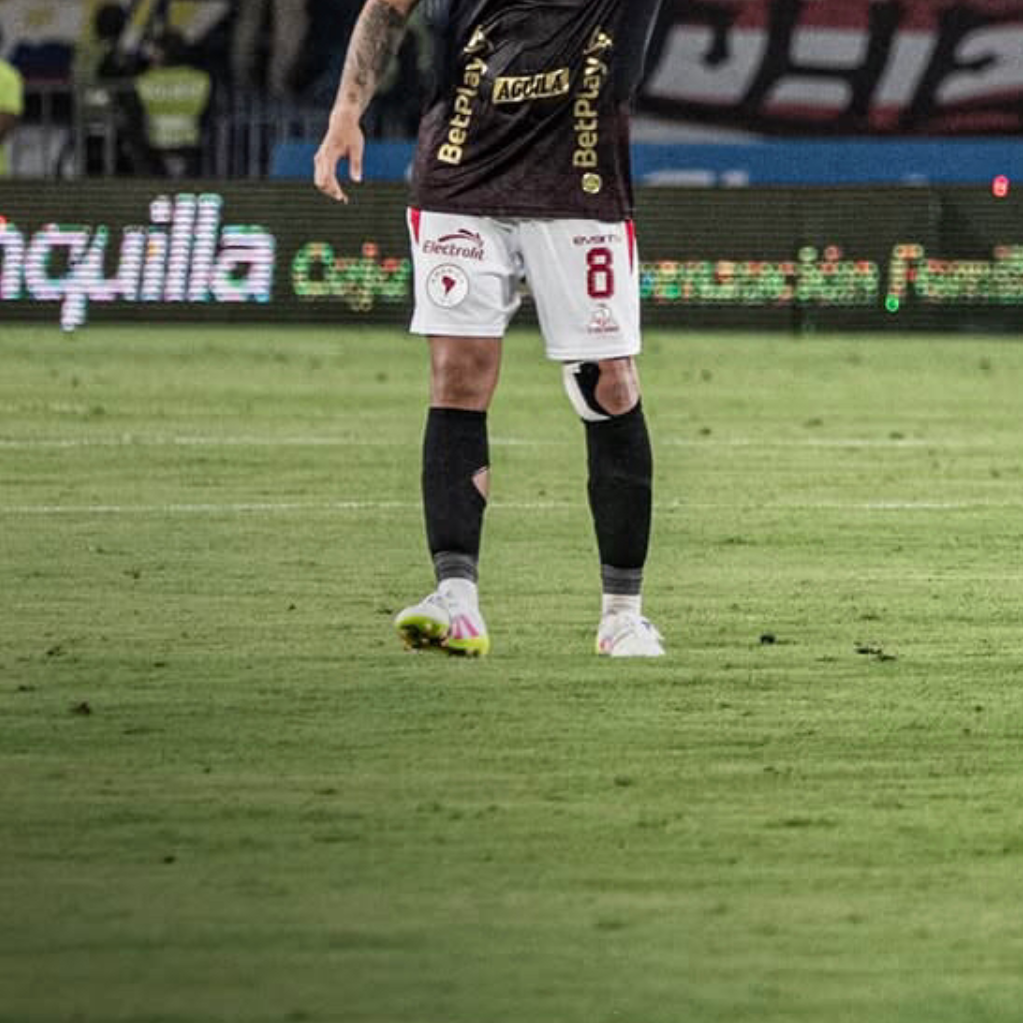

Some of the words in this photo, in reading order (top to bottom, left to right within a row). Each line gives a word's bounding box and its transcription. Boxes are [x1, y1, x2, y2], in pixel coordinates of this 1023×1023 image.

[437, 56, 489, 165] BetPlay
[572, 56, 608, 168] BetPlay
[586, 246, 615, 300] 8
